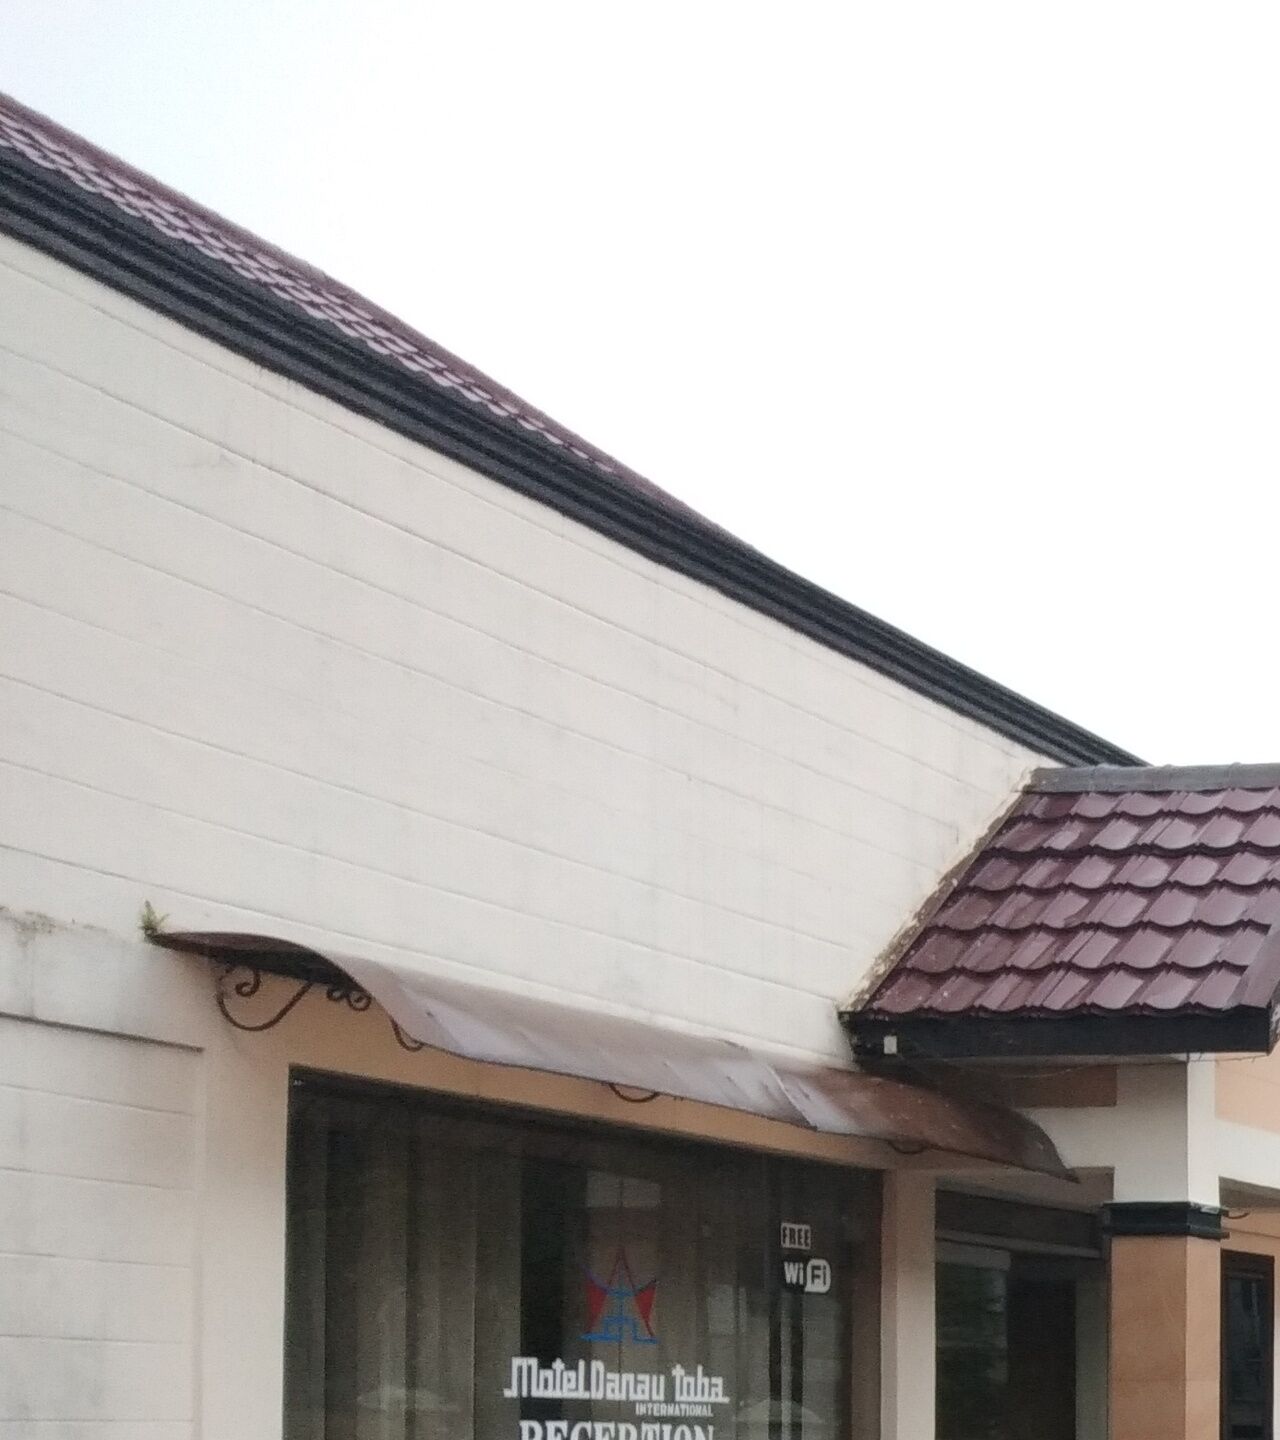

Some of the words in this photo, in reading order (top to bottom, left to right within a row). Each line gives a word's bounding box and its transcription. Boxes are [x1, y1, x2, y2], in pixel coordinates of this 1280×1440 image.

[782, 1225, 810, 1248] FREE
[503, 1356, 591, 1399] Motel
[590, 1359, 666, 1401] Danau
[635, 1402, 714, 1418] INTERNATIONAL
